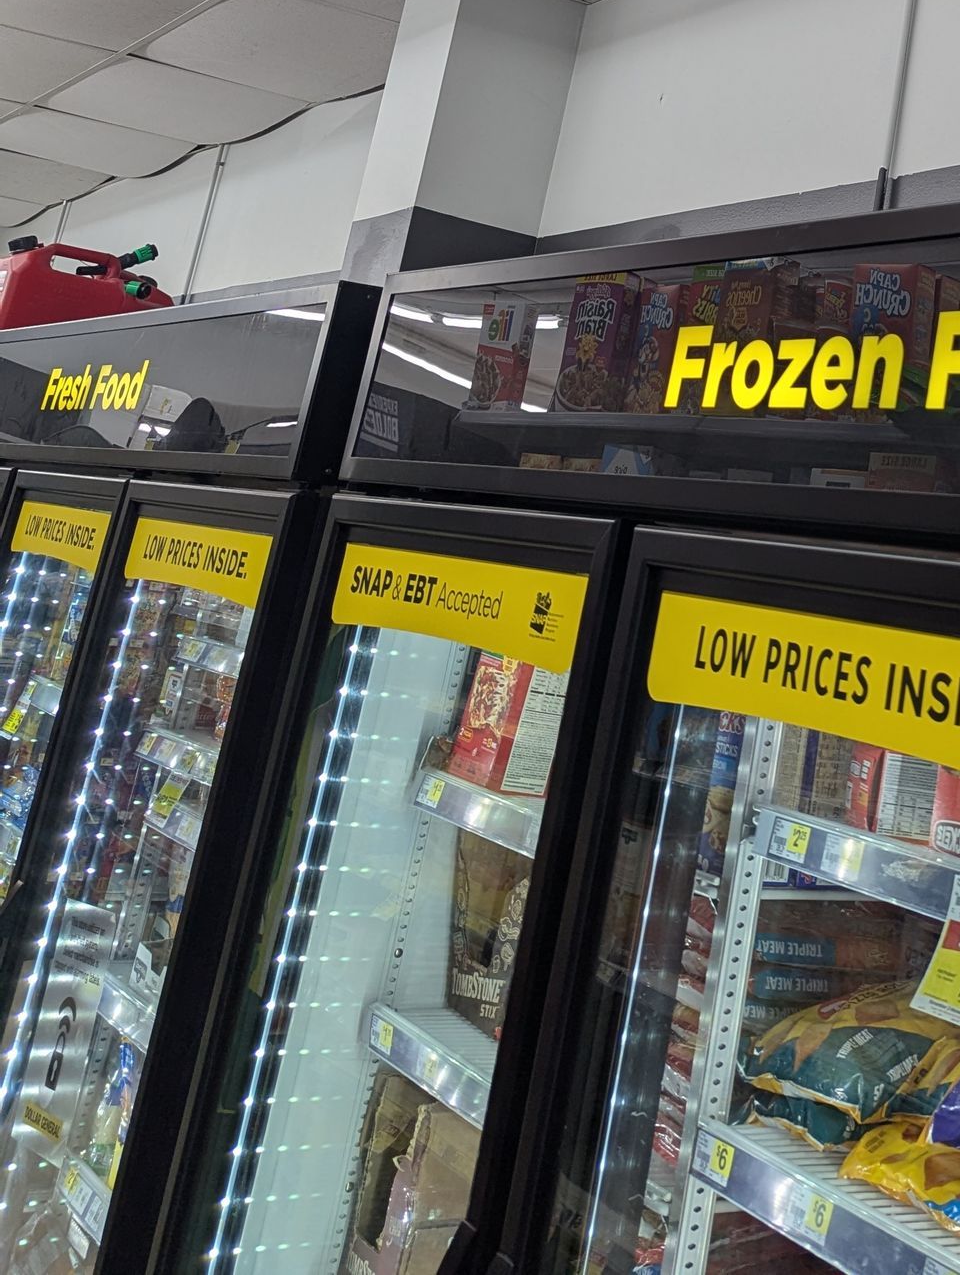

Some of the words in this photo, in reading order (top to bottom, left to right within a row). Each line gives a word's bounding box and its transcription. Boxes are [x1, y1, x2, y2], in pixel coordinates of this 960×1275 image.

[664, 325, 905, 410] Frozen
[41, 364, 92, 411] Fresh
[89, 360, 149, 410] Food
[25, 515, 42, 535] LOW
[42, 518, 66, 543] PRICES
[65, 524, 96, 551] INSIDE.
[143, 534, 166, 561] LOW
[165, 538, 204, 569] PRICES
[202, 546, 248, 580] INSIDE.
[350, 565, 394, 598] SNAP
[391, 575, 402, 600] &
[403, 573, 438, 606] EBT
[435, 582, 504, 620] Accepted
[694, 625, 756, 679] LOW
[763, 638, 871, 705] PRICES
[716, 742, 739, 757] STICKS
[756, 939, 786, 955] MEAT
[787, 941, 823, 958] TRIPLE
[452, 968, 506, 1003] TOMBSTONE
[765, 976, 793, 991] MEAT
[794, 977, 829, 993] TRIPLE
[480, 1004, 500, 1019] STIX
[836, 1038, 857, 1059] TRIPLE
[854, 1029, 874, 1046] MEAT
[24, 1106, 42, 1124] DOLLAR
[41, 1115, 61, 1139] GENERAL
[716, 1145, 728, 1171] $6
[812, 1200, 827, 1228] $6
